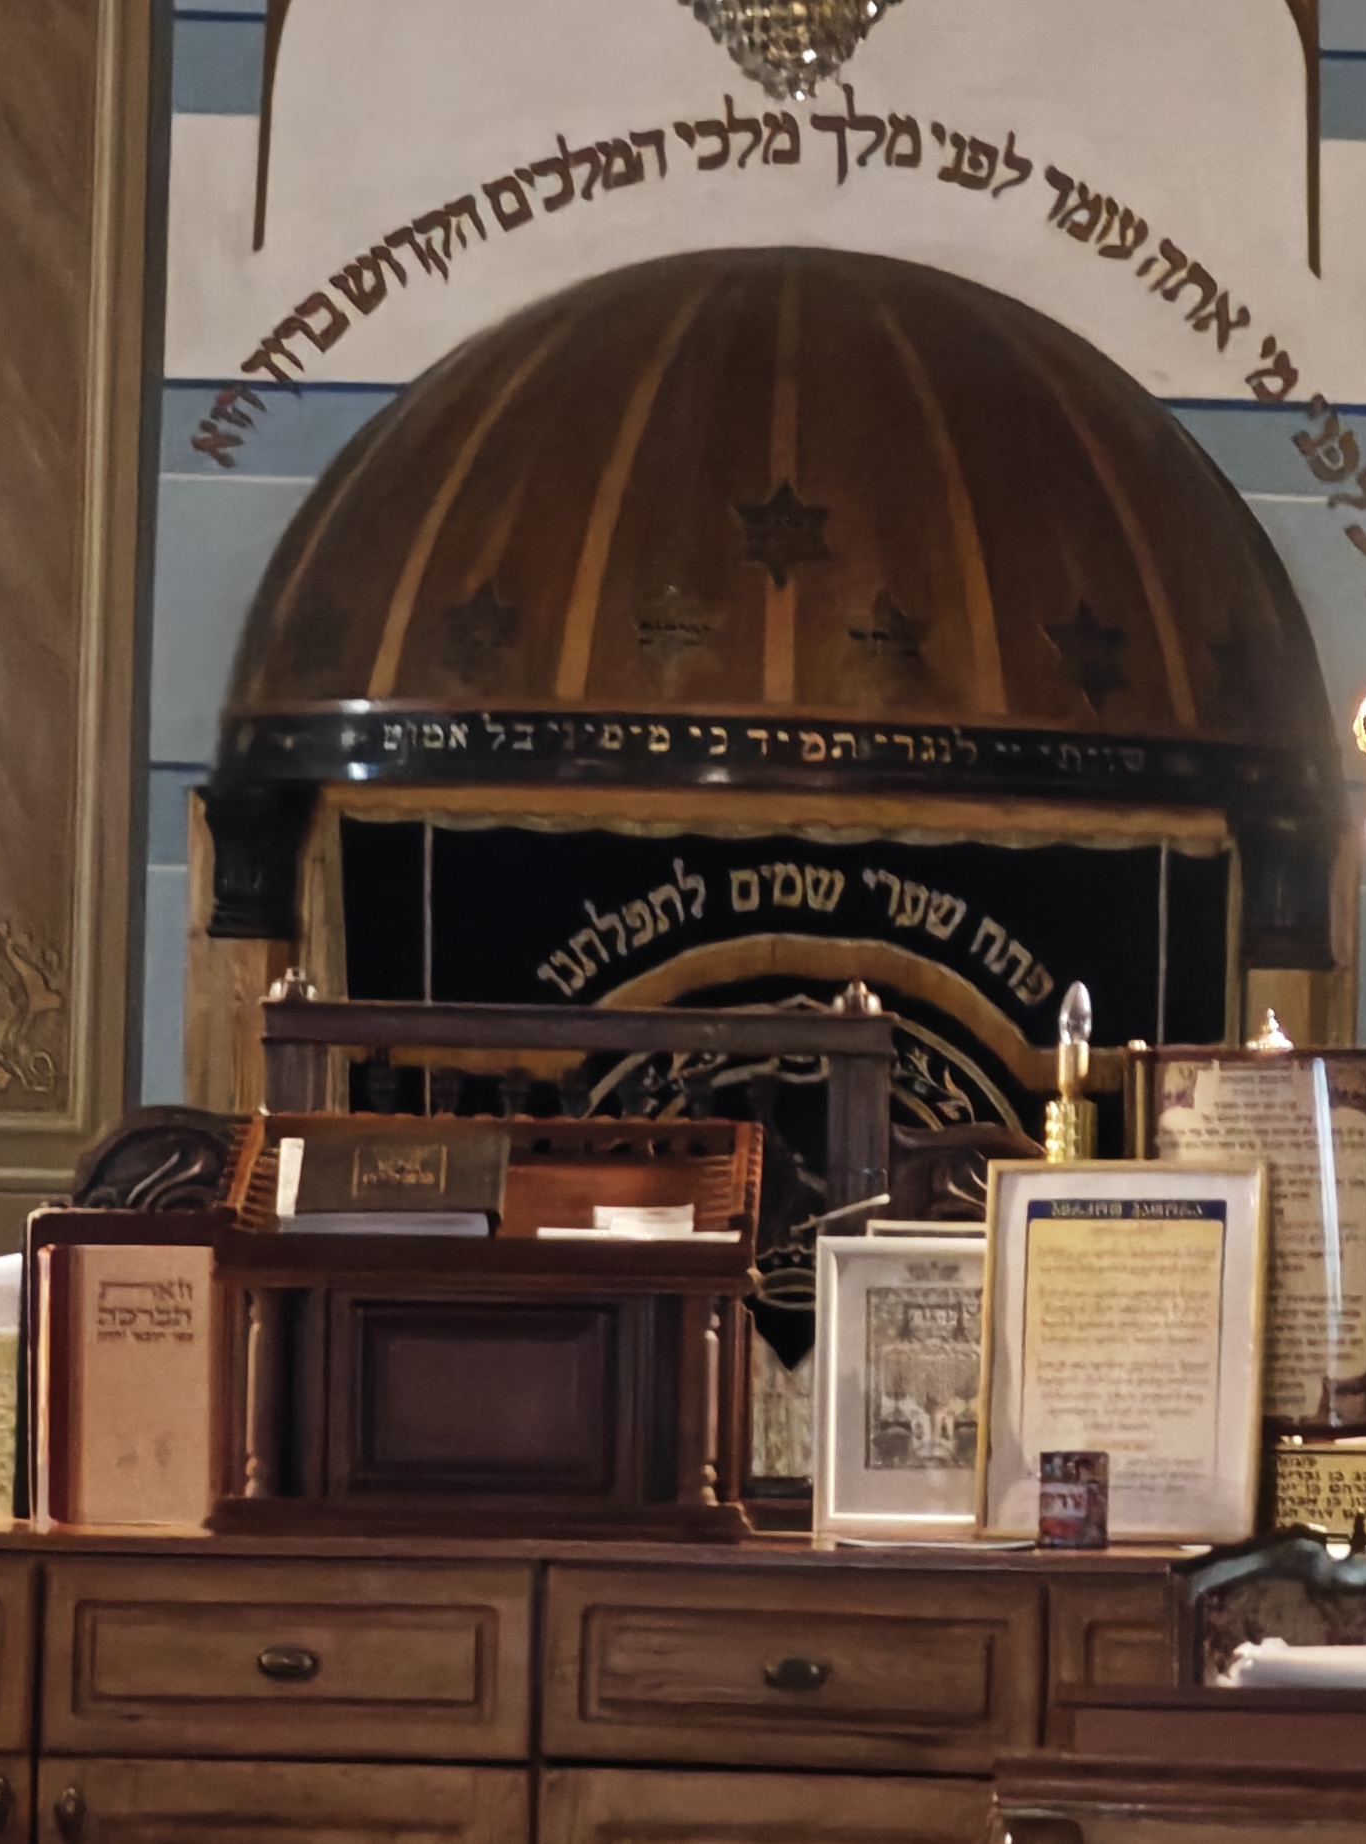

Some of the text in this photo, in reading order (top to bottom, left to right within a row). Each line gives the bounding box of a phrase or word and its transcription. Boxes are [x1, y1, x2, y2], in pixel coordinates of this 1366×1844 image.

[673, 94, 801, 170] מלכי
[810, 83, 922, 187] מלך
[930, 130, 1033, 199] לפני
[482, 132, 668, 232] המלכים
[1044, 163, 1150, 261] עומד
[329, 194, 488, 316] הקדוש
[1136, 238, 1251, 353] אתה
[240, 292, 352, 399] ברוך
[1244, 335, 1300, 402] מי
[191, 382, 267, 469] הוא
[481, 712, 535, 752] בל
[688, 726, 728, 756] כי
[746, 728, 857, 763] תמיד
[537, 856, 1055, 1007] פתח שערי שמים לתפלתנו
